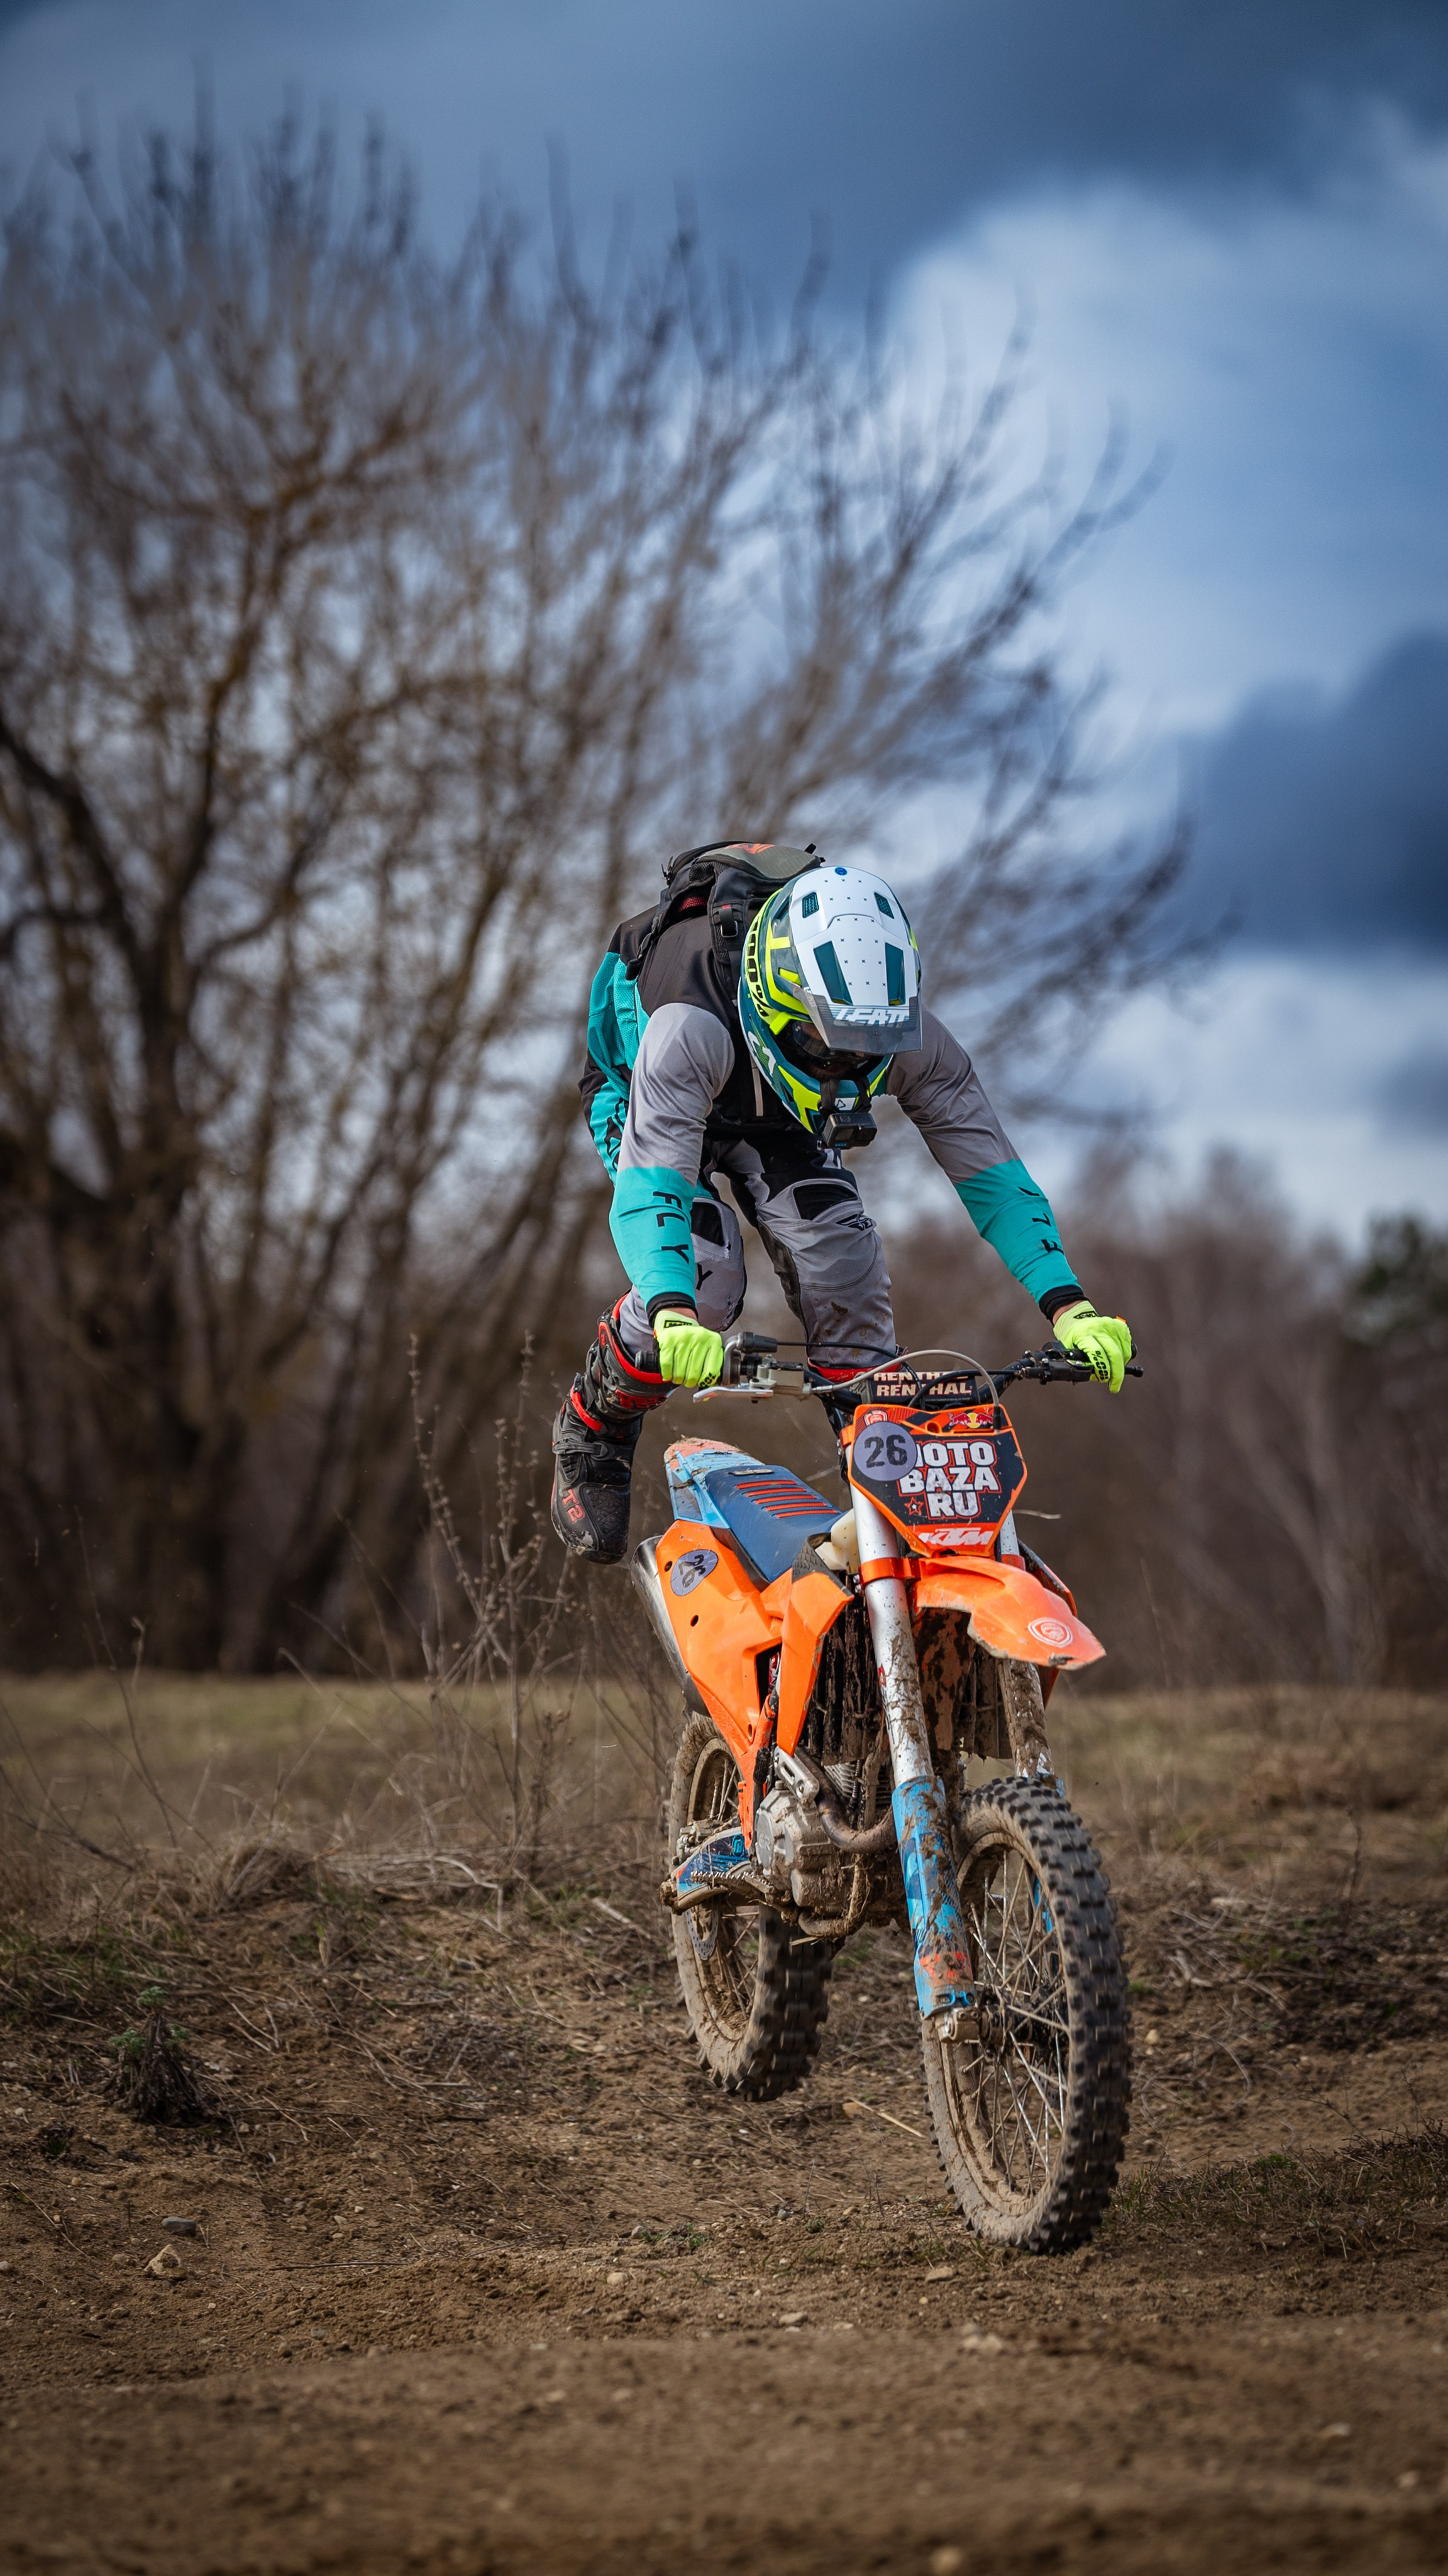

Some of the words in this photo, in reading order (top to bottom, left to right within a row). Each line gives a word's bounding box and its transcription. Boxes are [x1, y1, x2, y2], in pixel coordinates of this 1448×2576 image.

[834, 1008, 909, 1028] LEATT
[653, 1191, 690, 1265] FLY
[874, 1372, 968, 1381] RENTH
[876, 1382, 972, 1396] RENHAL
[865, 1434, 907, 1468] 26
[899, 1467, 999, 1494] BAZA
[927, 1492, 978, 1517] RU
[918, 1527, 994, 1546] KTM
